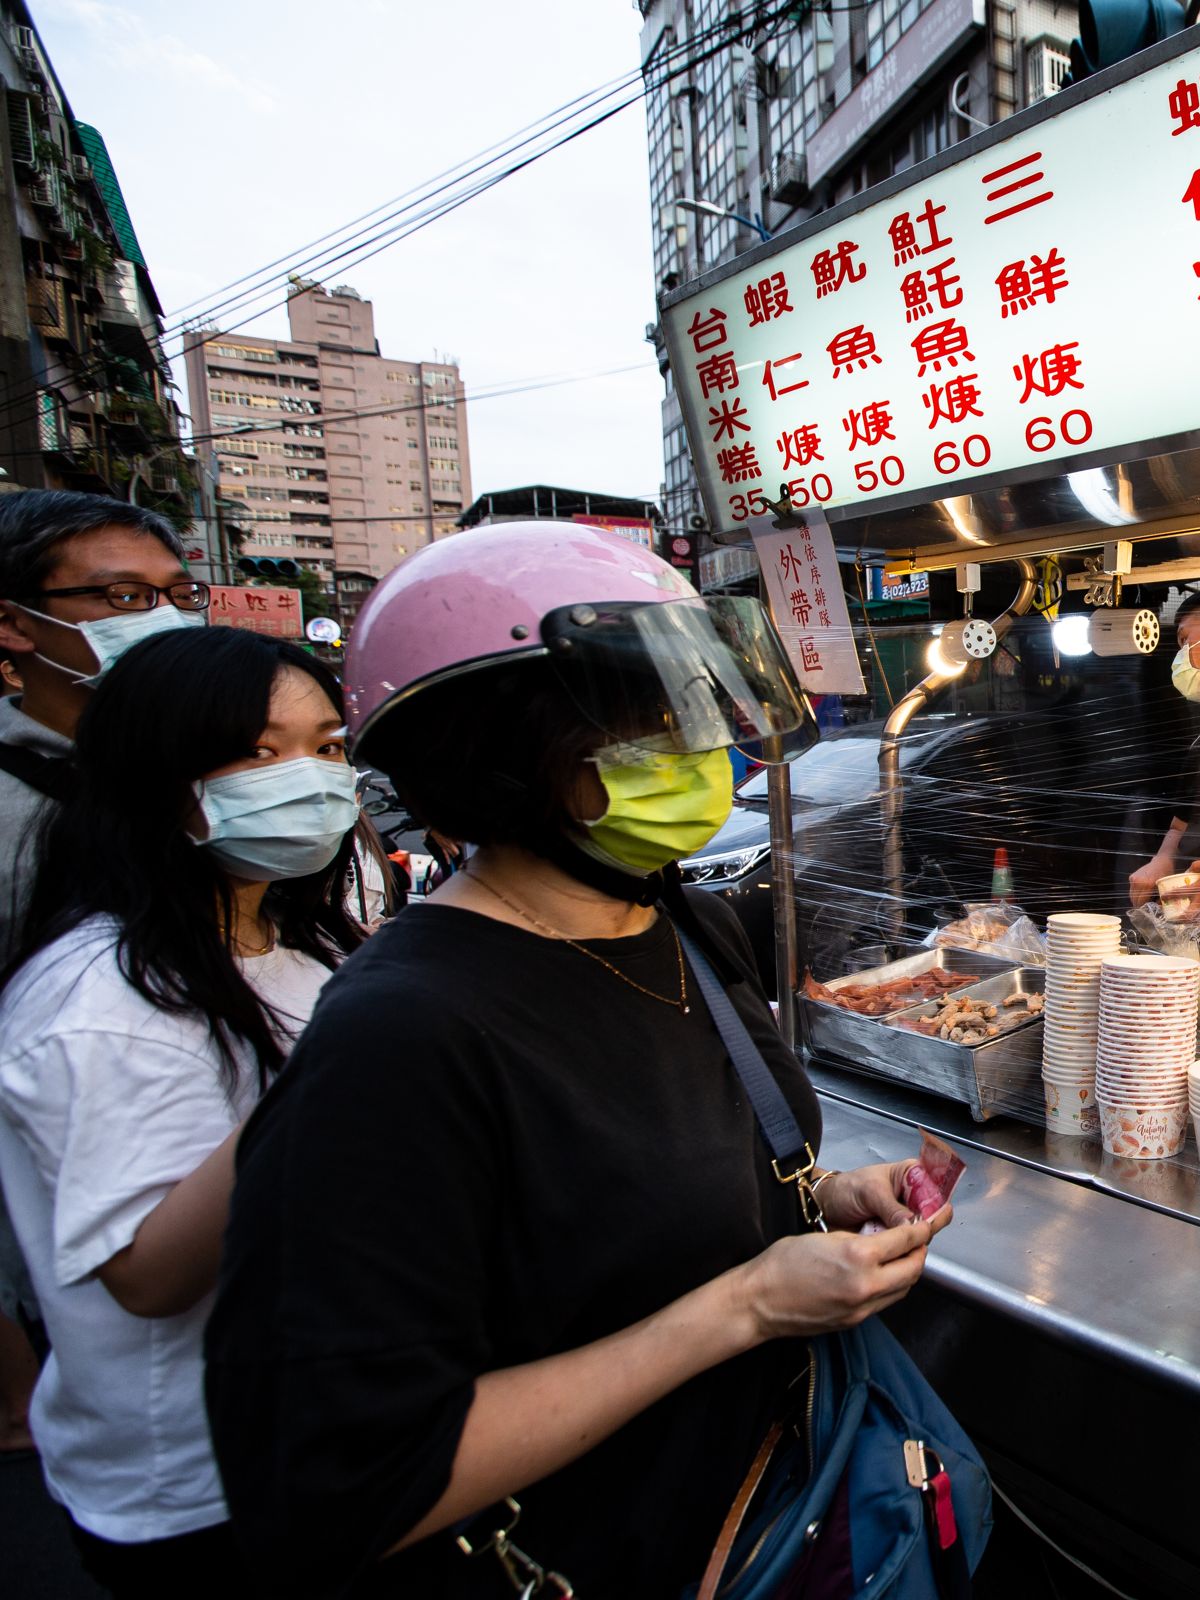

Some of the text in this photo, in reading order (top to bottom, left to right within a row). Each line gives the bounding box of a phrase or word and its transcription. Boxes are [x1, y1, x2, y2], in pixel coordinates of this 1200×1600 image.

[810, 240, 897, 452] 魷魚焿
[981, 152, 1093, 453] 三鮮焿 60
[688, 307, 763, 485] 台南米糕
[728, 487, 768, 522] 35
[744, 271, 833, 508] 蝦仁焿 50
[853, 455, 905, 493] 50
[933, 433, 992, 475] 60
[779, 543, 824, 673] 外帶區
[799, 524, 832, 629] 請依序排隊
